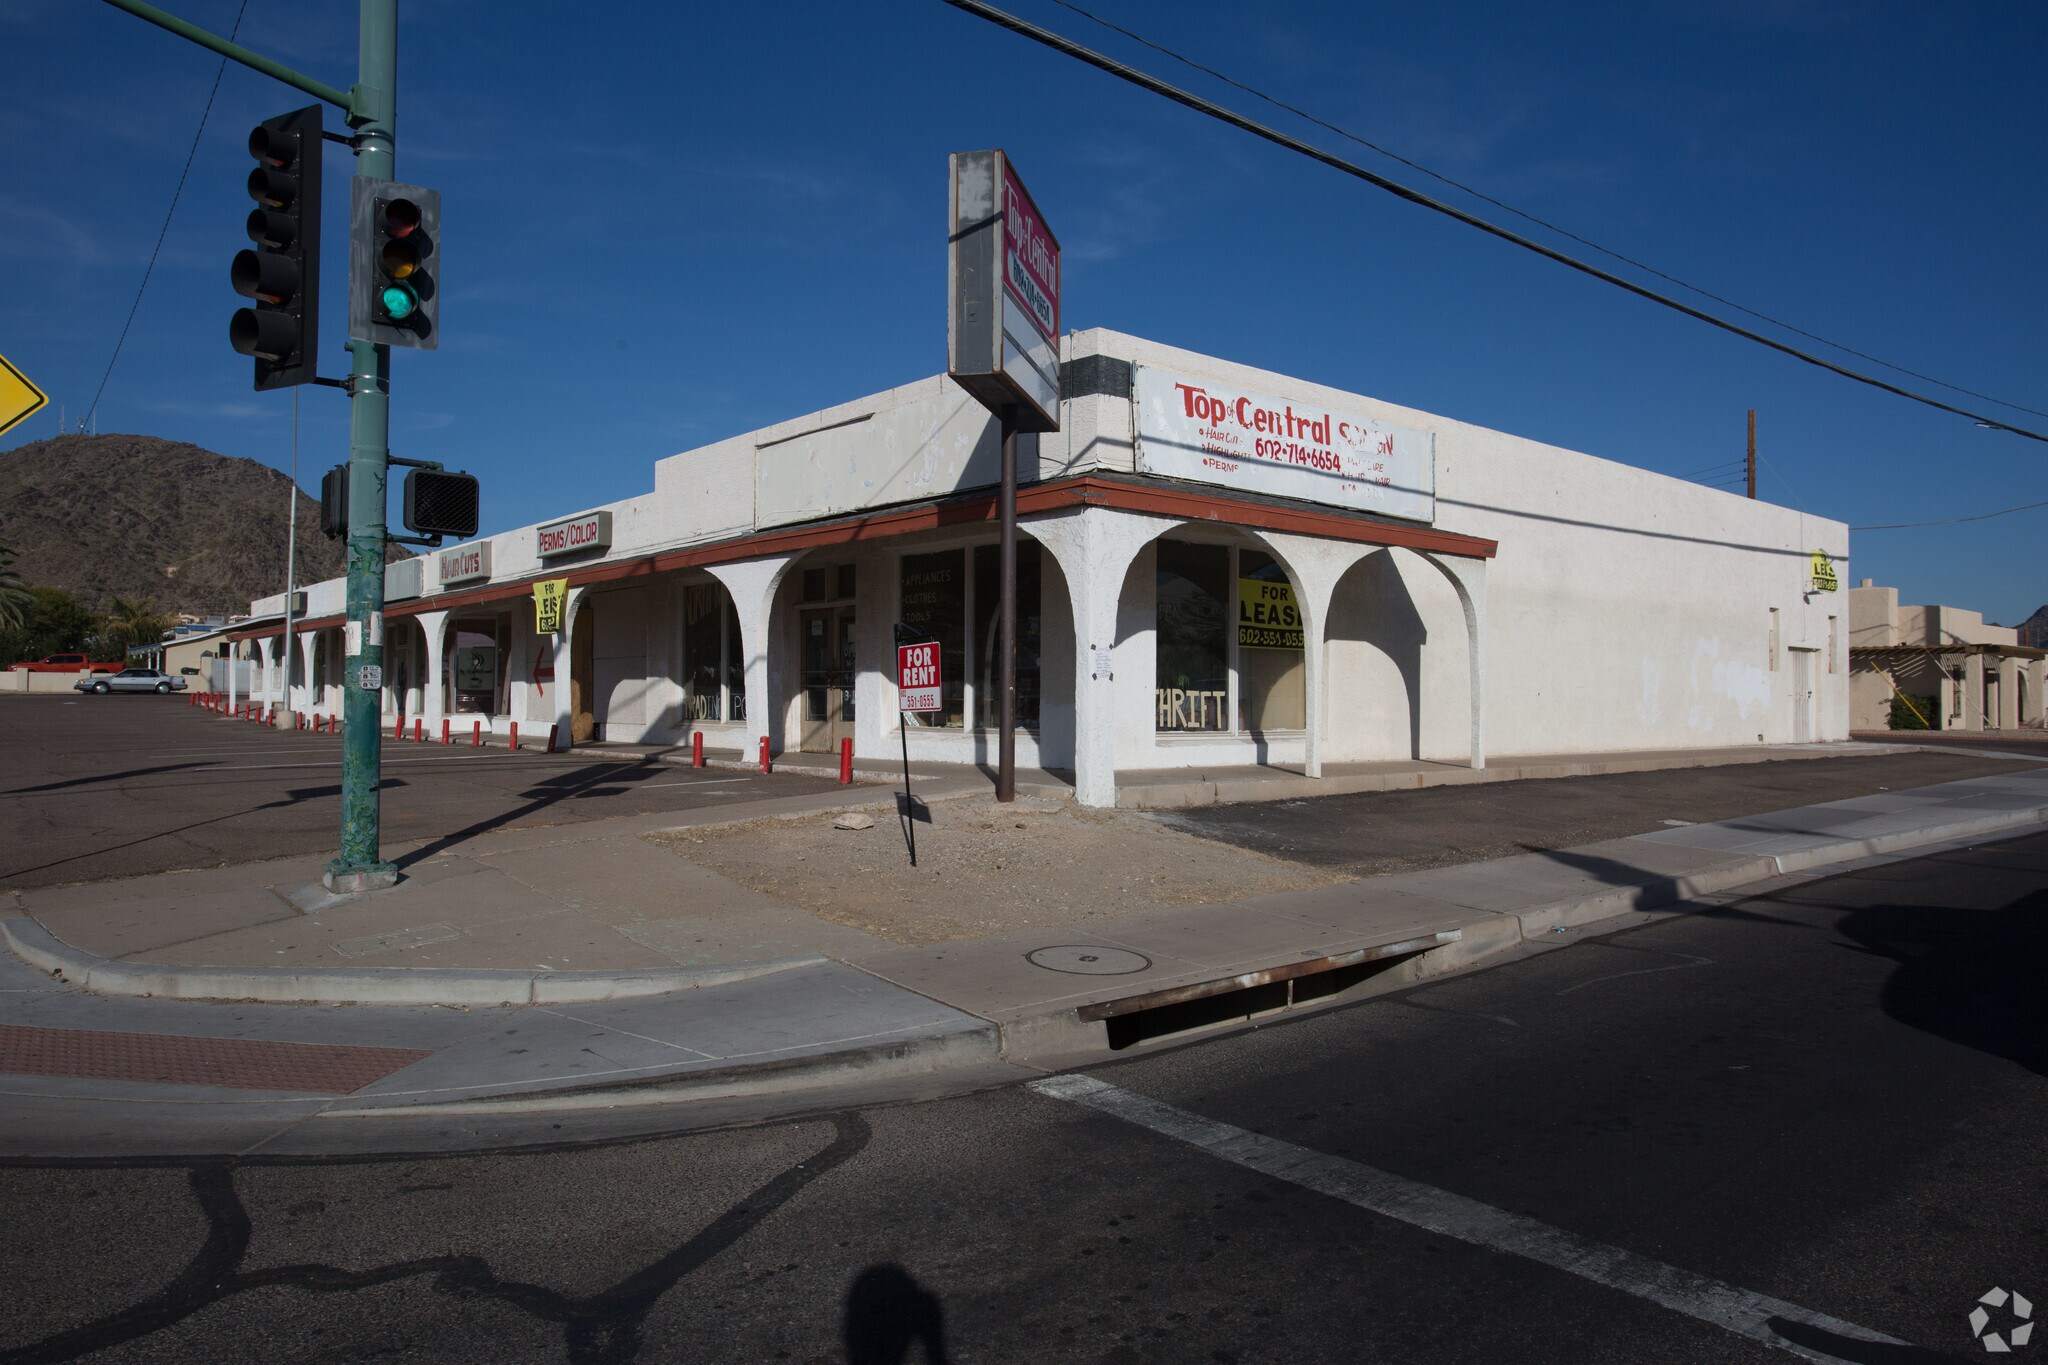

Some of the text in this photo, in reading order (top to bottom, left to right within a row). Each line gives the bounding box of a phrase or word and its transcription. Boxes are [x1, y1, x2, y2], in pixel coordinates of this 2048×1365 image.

[1004, 178, 1023, 258] Top
[1027, 216, 1056, 298] Central
[1175, 382, 1226, 428] Top
[1236, 397, 1331, 446] Central
[1205, 427, 1225, 442] HAIR
[539, 521, 597, 553] PERMS/COLOR
[905, 569, 952, 588] APPLIANCES
[905, 592, 937, 604] CLOTHES
[1261, 586, 1288, 601] FOR
[906, 611, 931, 623] TOOLS
[907, 647, 932, 668] FOR
[903, 666, 935, 687] RENT
[1156, 688, 1226, 729] HRIFT
